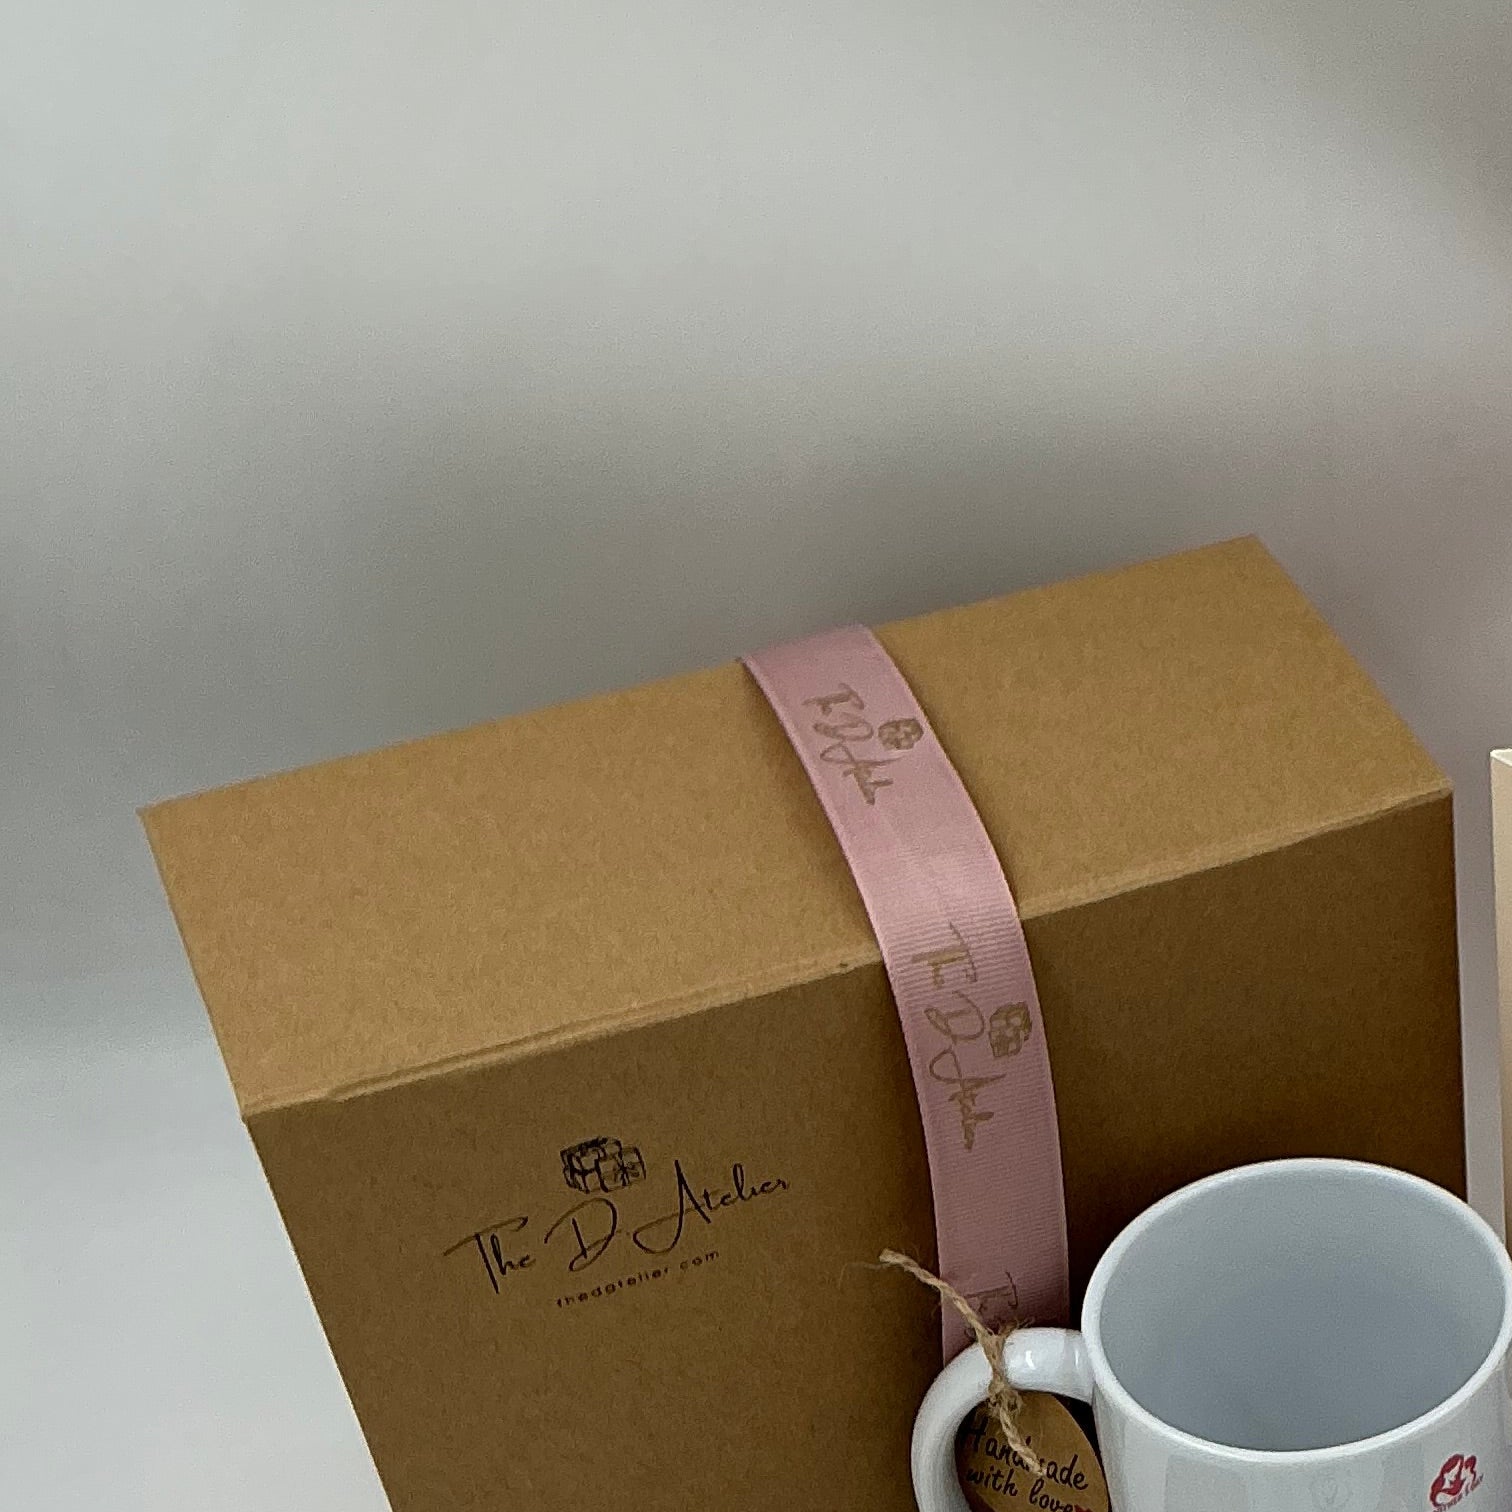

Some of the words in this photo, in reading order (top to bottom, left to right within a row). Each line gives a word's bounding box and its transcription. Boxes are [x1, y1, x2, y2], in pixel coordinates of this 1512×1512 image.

[443, 1216, 537, 1294] The
[544, 1197, 620, 1272] D
[633, 1160, 790, 1254] Atelier
[958, 1412, 1088, 1490] Handade
[966, 1465, 1018, 1496] with
